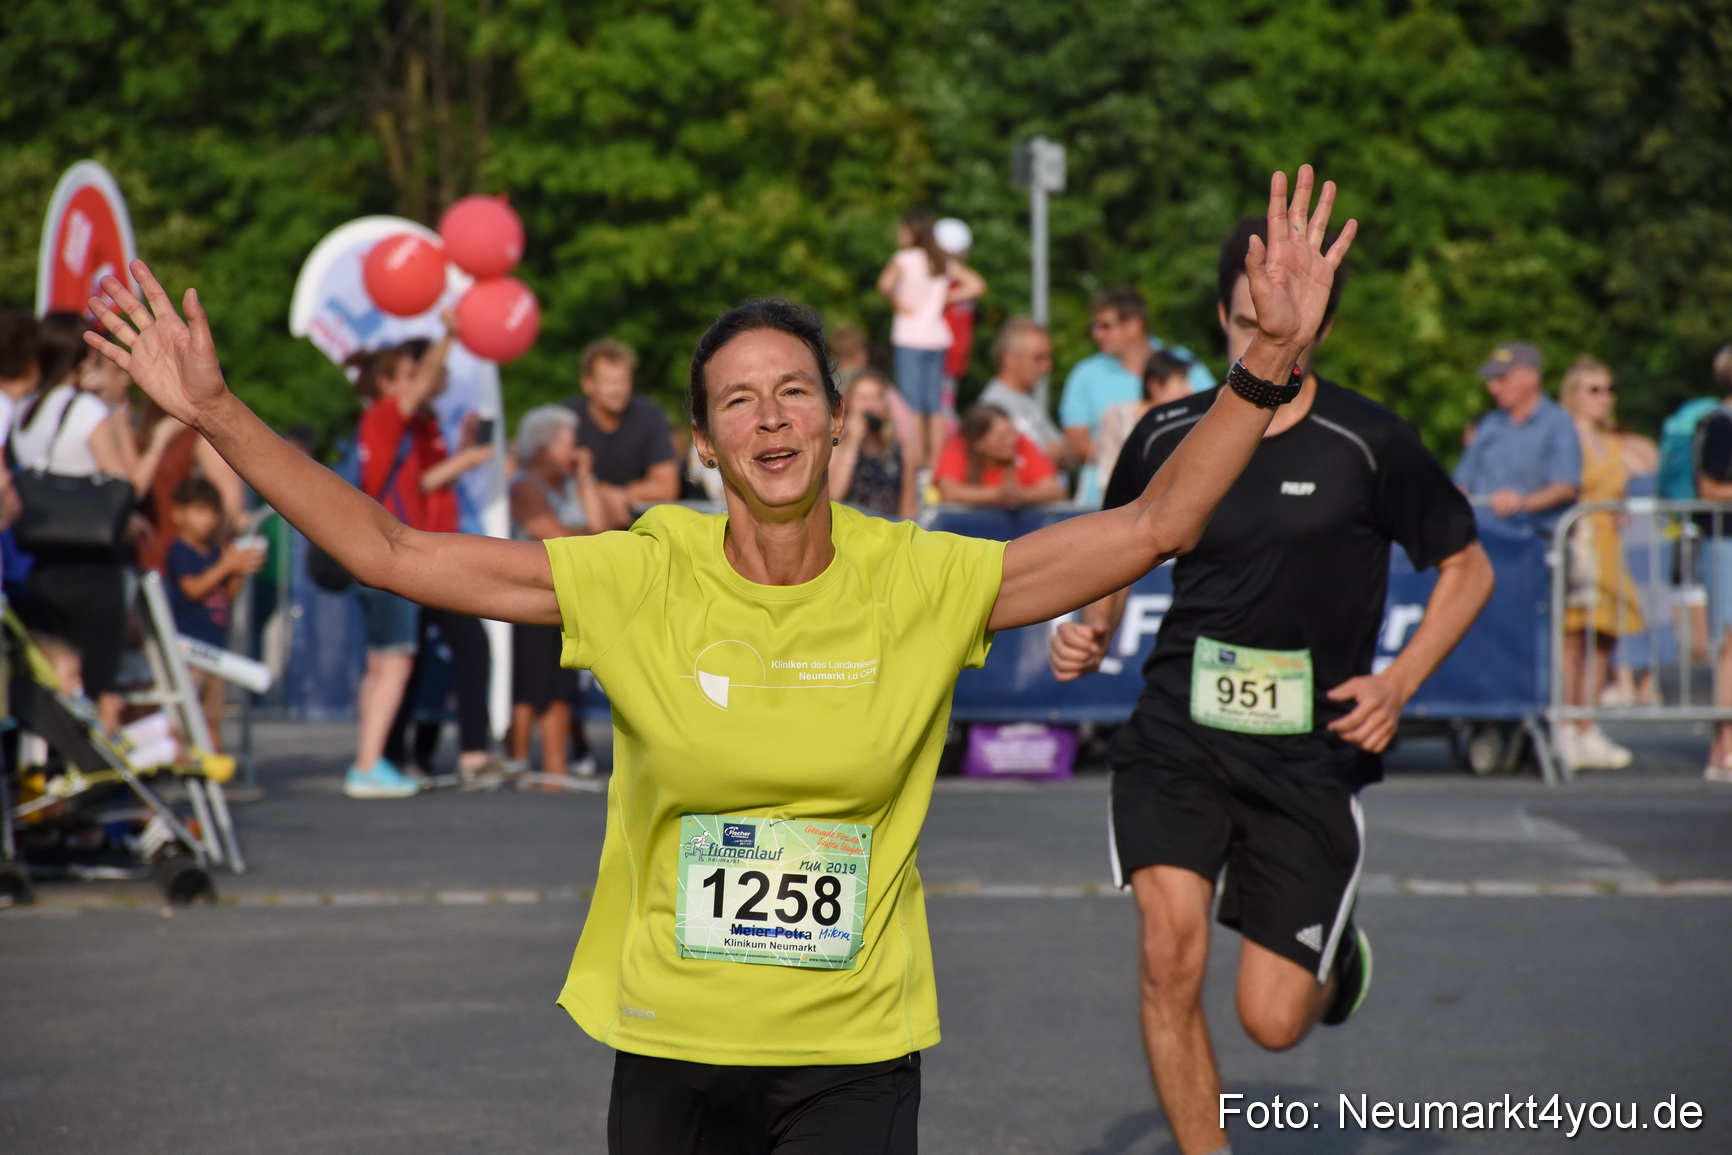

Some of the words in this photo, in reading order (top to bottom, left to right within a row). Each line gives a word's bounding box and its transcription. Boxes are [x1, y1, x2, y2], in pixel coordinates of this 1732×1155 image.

[771, 660, 808, 669] Kliniken
[811, 661, 826, 669] des
[829, 659, 877, 669] Landkreises
[799, 672, 845, 681] Neumarkt
[1217, 676, 1277, 709] 951
[708, 843, 784, 862] firmenlauf
[826, 862, 857, 874] 2019
[703, 868, 842, 926] 1258
[731, 923, 770, 938] Meier
[775, 926, 812, 940] Petra
[724, 938, 767, 949] Klinikum
[769, 941, 817, 952] Neumarkt
